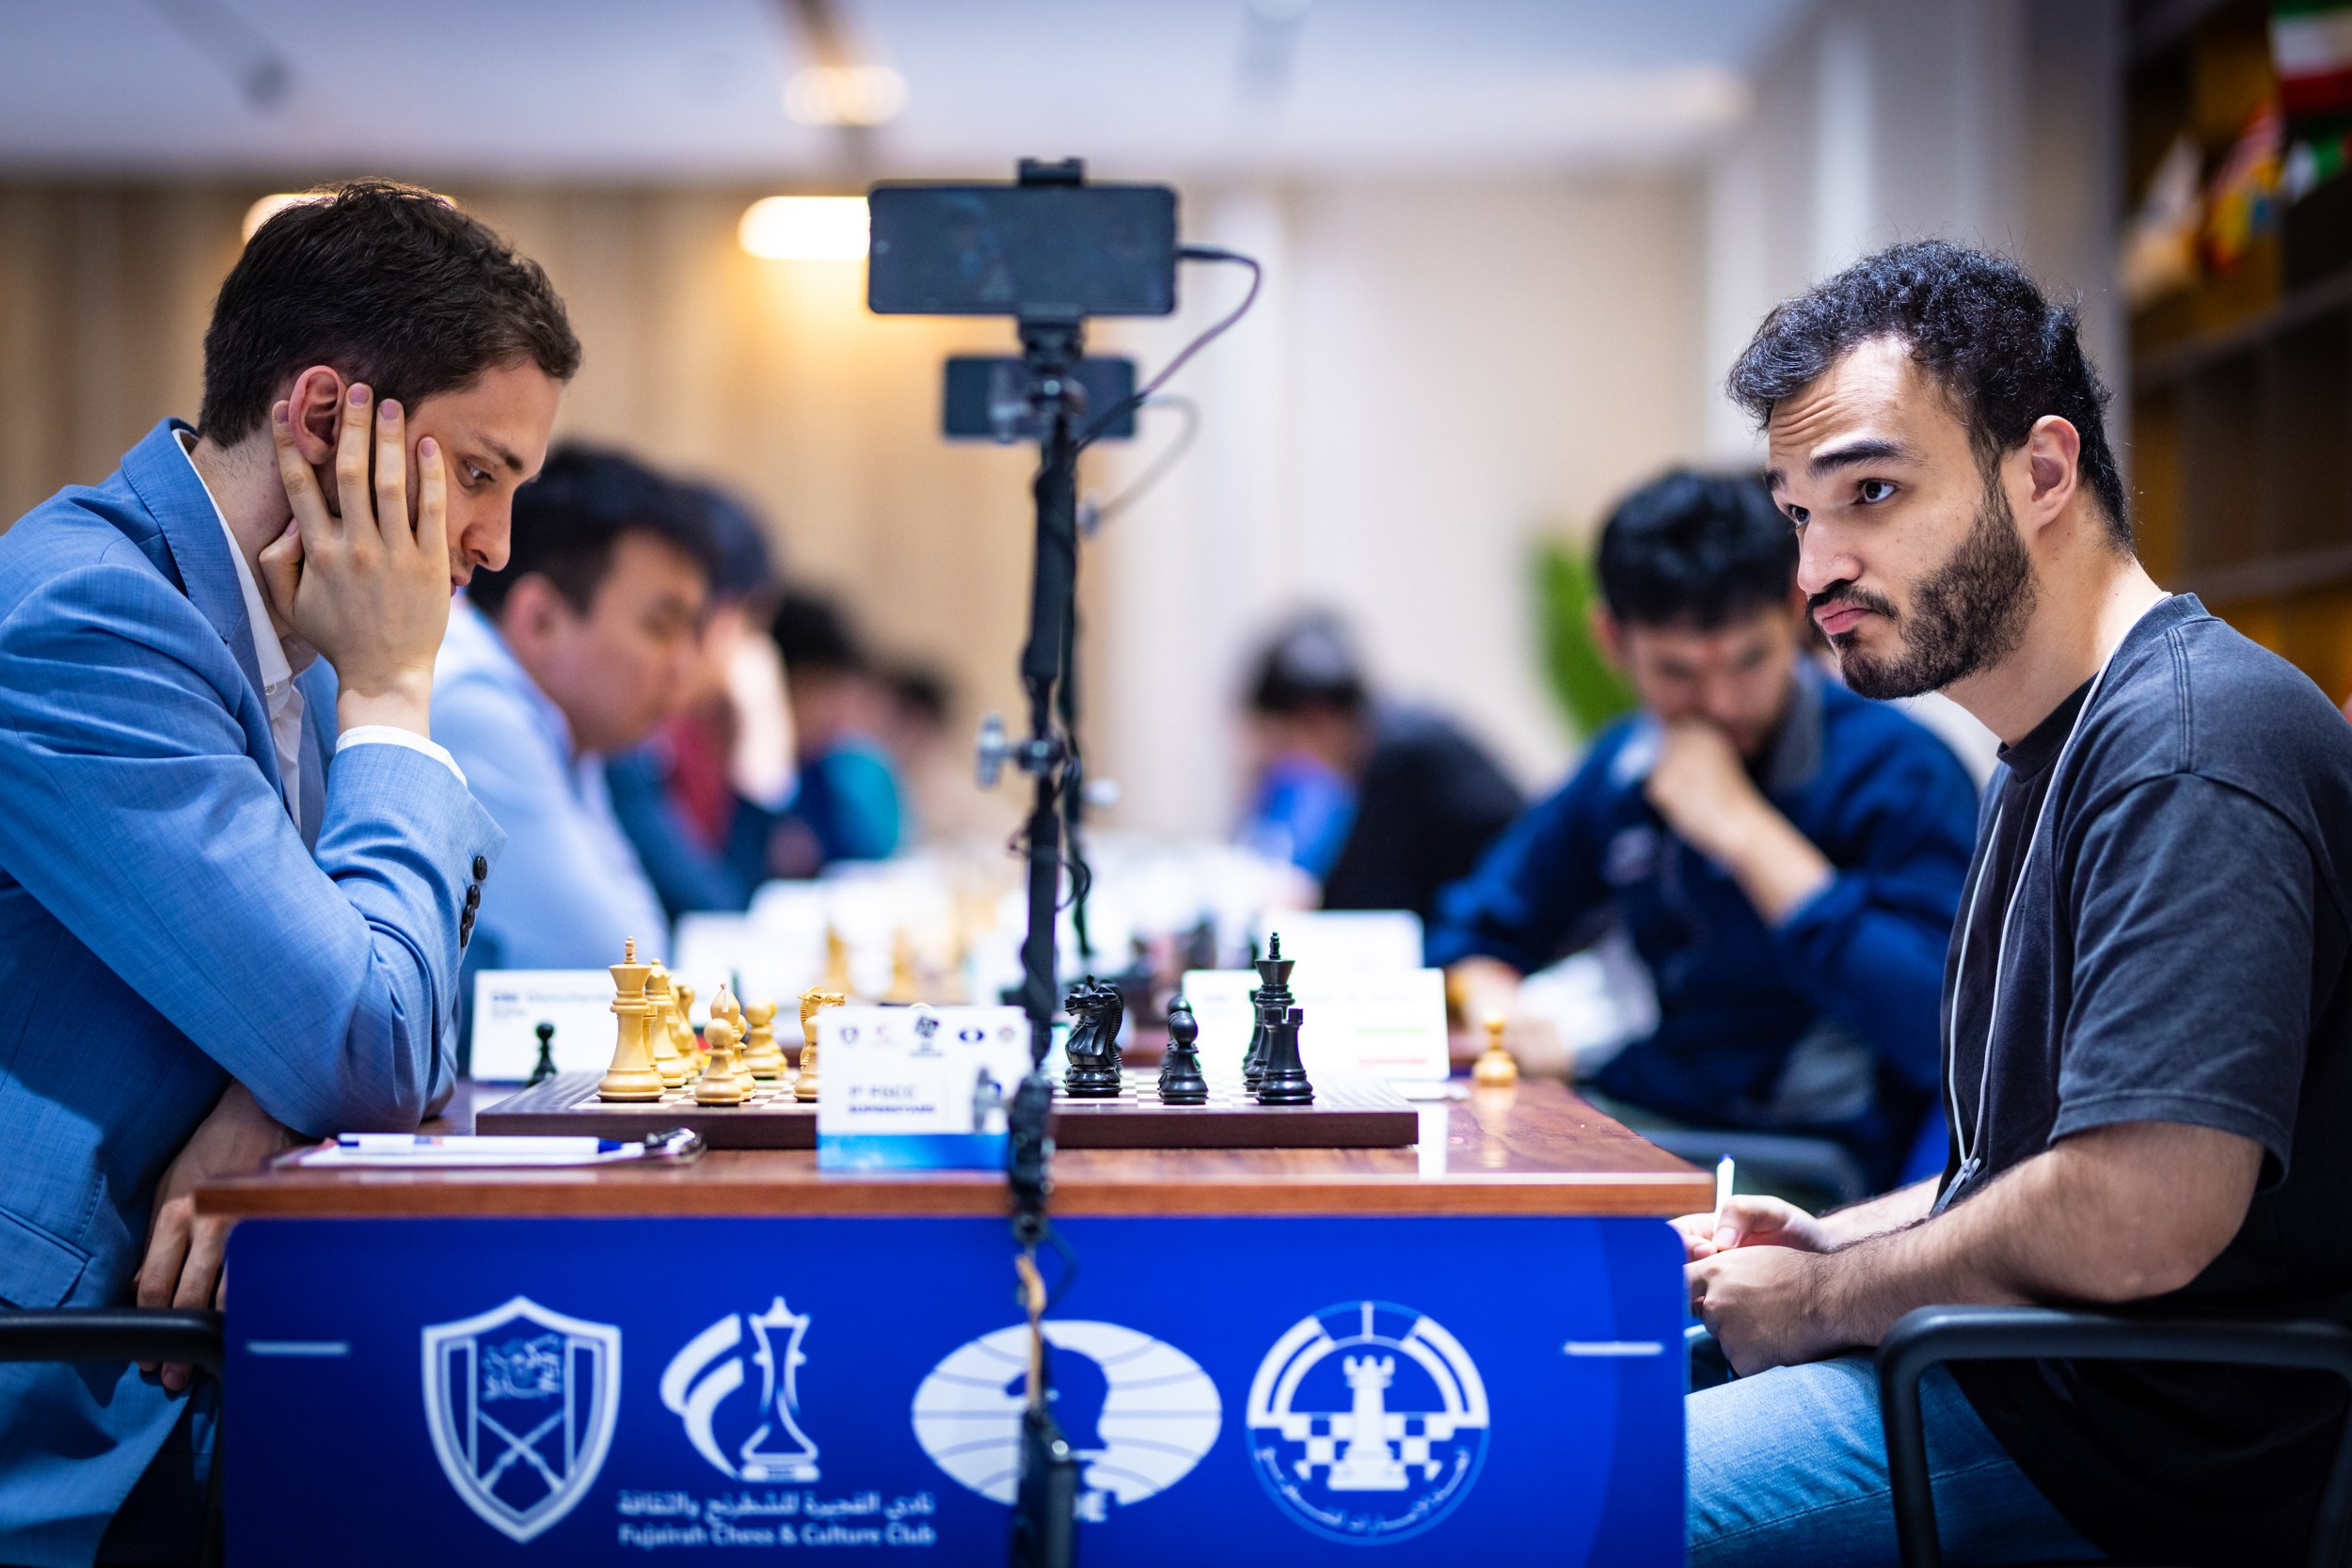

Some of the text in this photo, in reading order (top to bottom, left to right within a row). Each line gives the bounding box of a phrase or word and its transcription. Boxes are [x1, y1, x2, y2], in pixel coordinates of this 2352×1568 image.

[884, 1491, 935, 1521] نادي
[618, 1522, 936, 1549] Fujairah Chess & Culture Club
